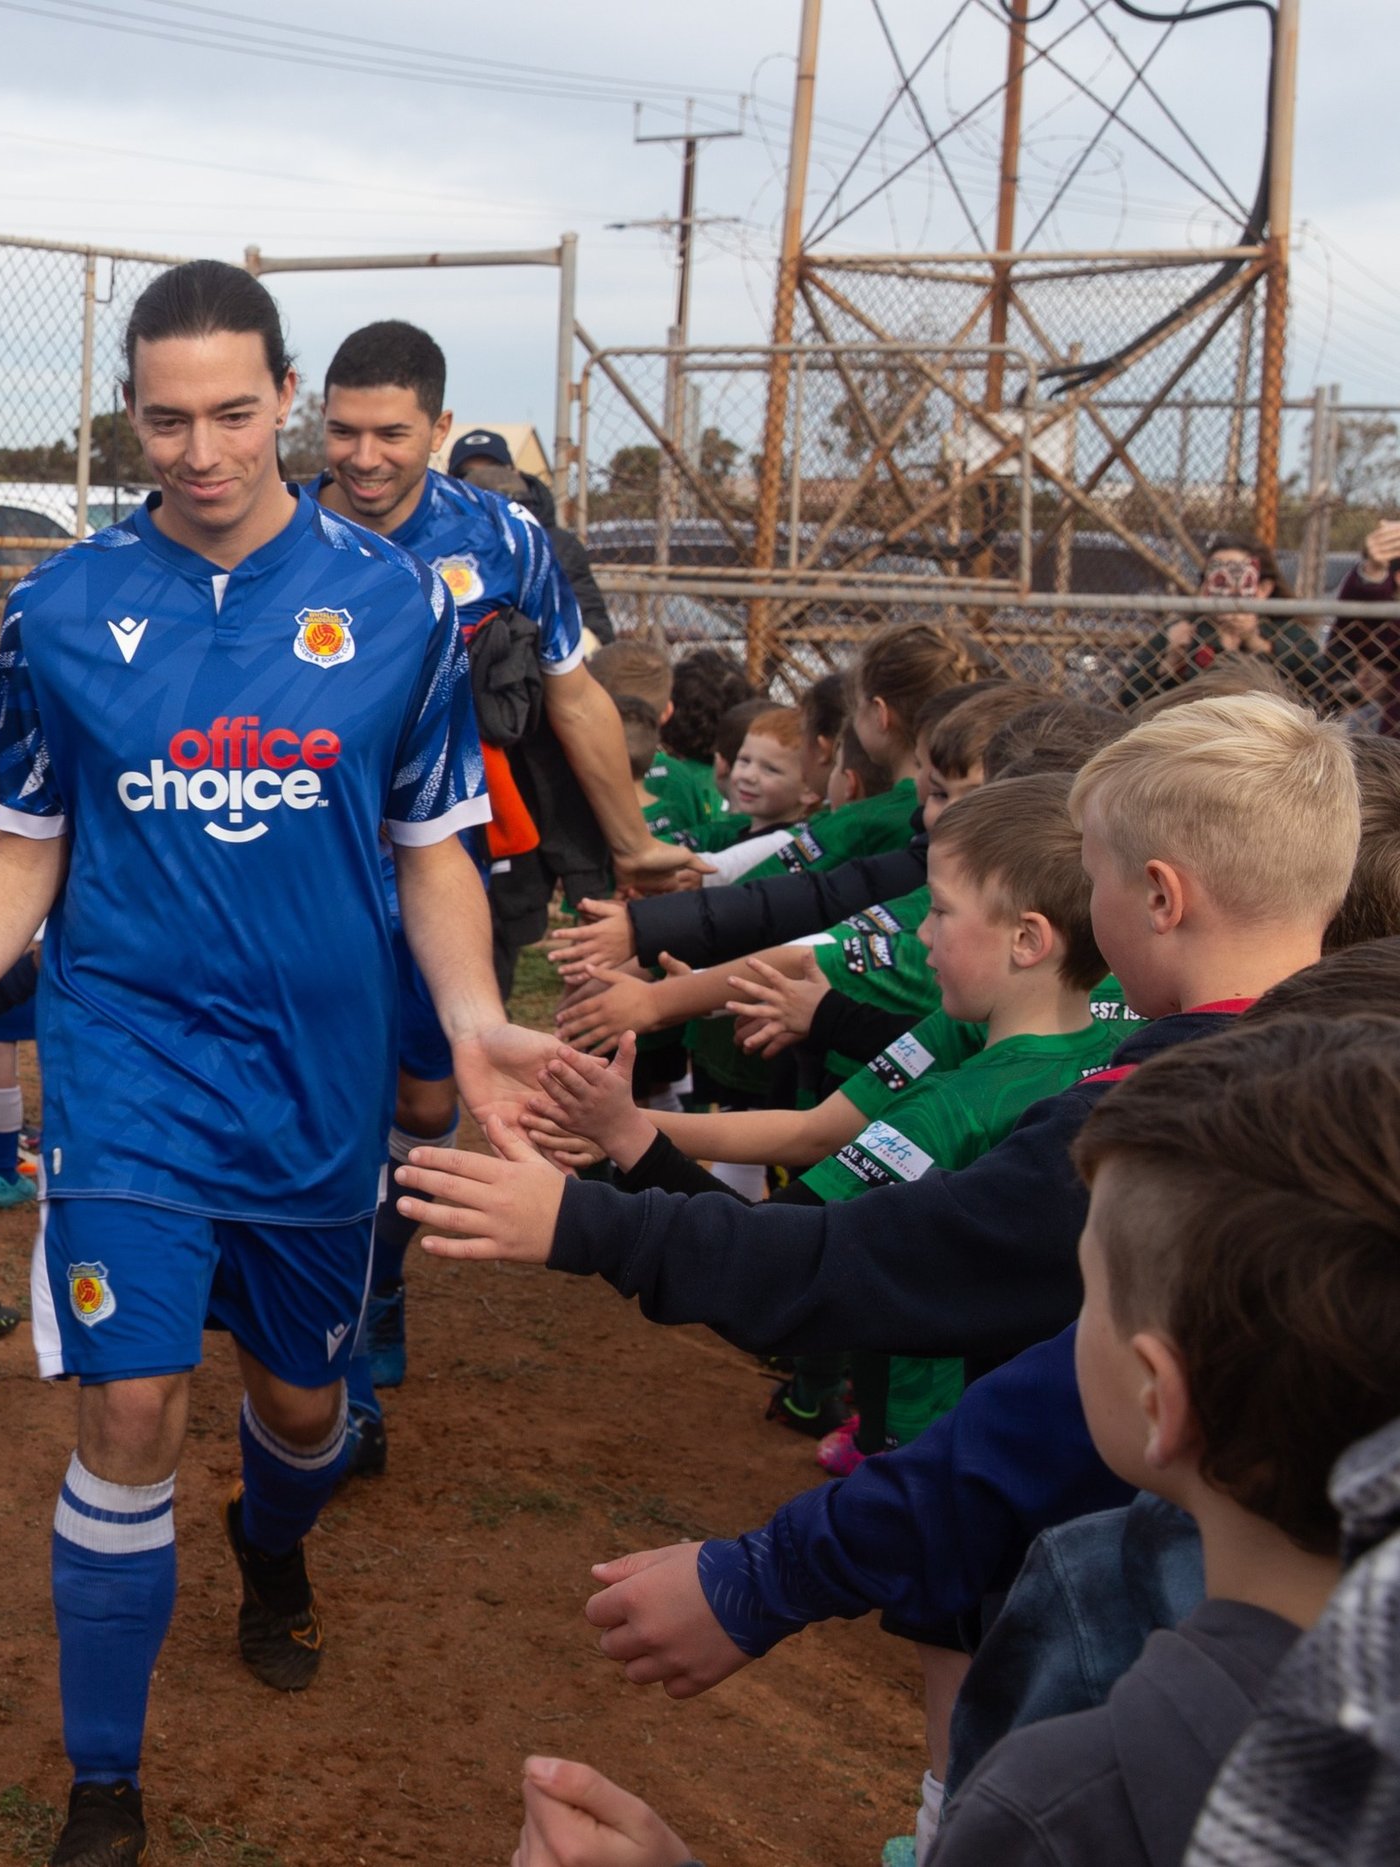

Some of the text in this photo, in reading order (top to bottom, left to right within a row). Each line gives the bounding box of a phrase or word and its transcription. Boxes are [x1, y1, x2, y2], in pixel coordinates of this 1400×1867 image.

[169, 716, 341, 769] office
[1090, 1002, 1120, 1019] EST.
[859, 1157, 888, 1182] SPEC
